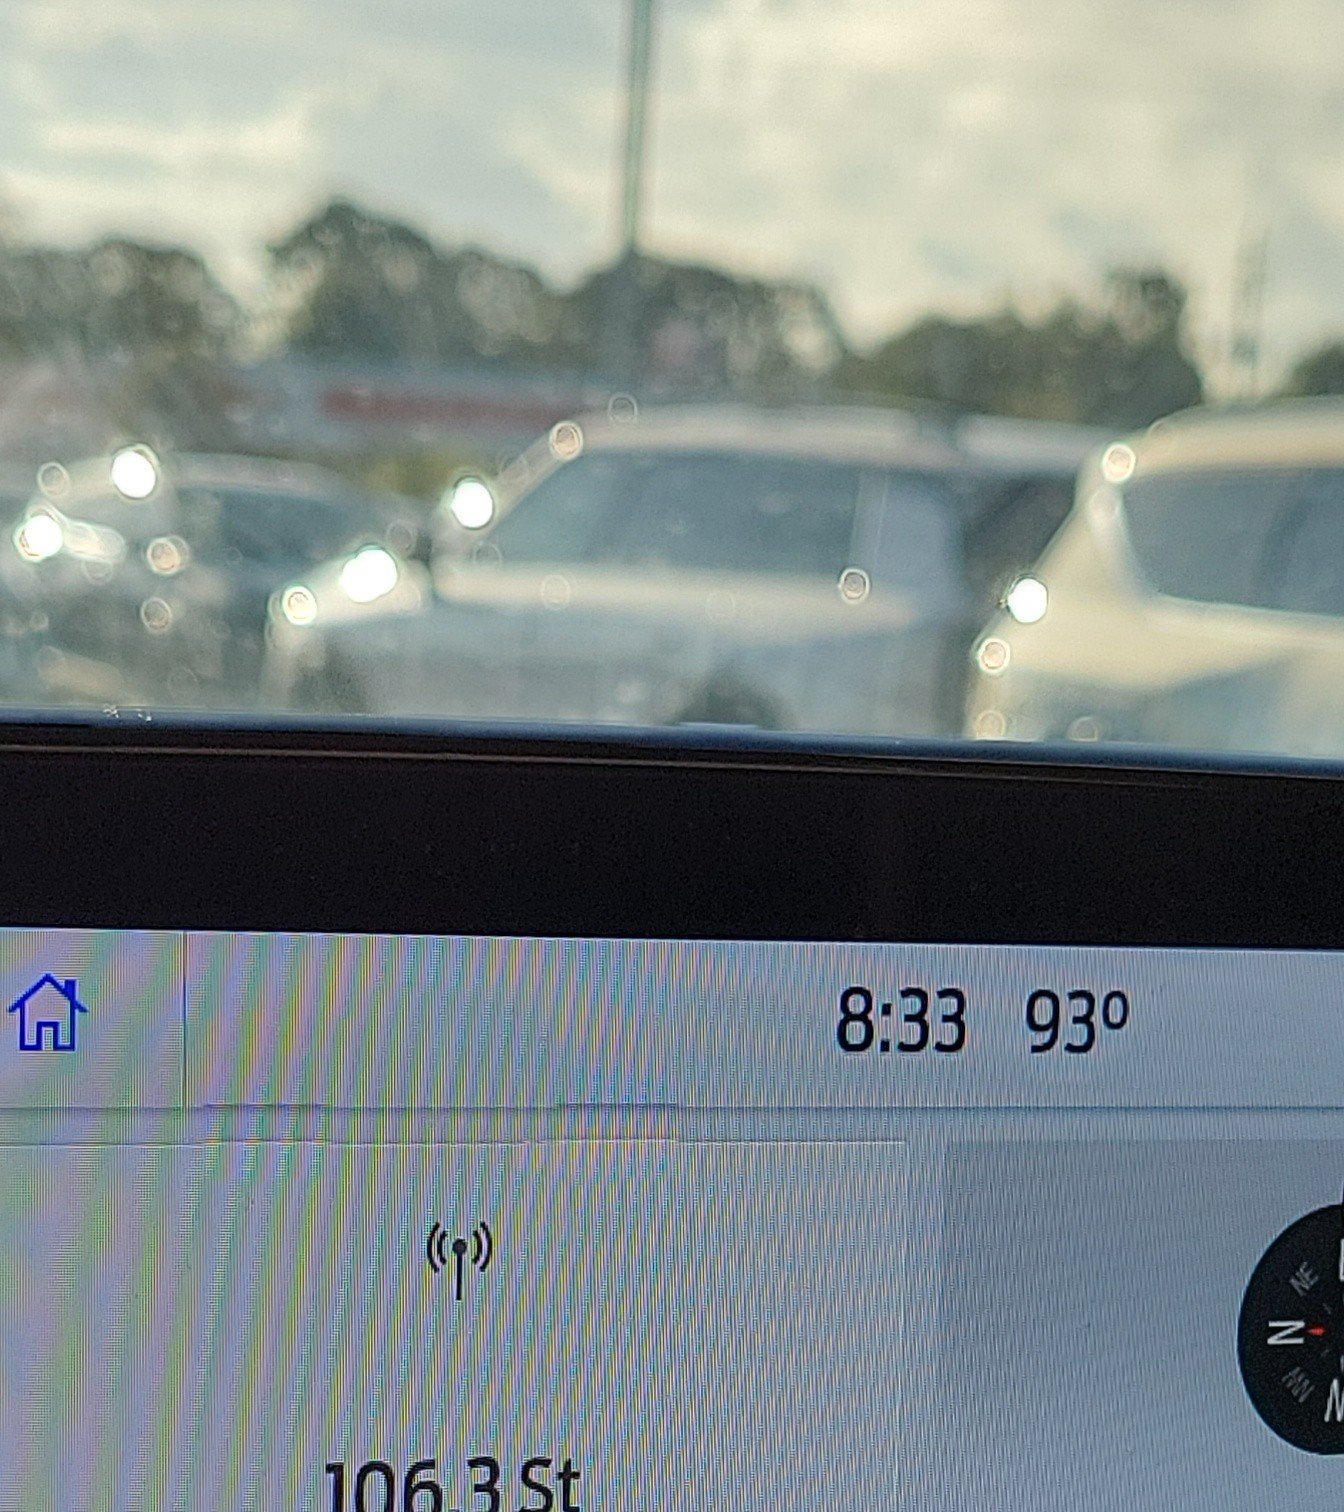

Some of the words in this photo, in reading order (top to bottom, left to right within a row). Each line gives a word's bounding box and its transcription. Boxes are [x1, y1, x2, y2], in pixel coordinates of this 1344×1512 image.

[837, 986, 967, 1053] 8:33
[1289, 1260, 1320, 1298] NE
[1267, 1319, 1306, 1345] N
